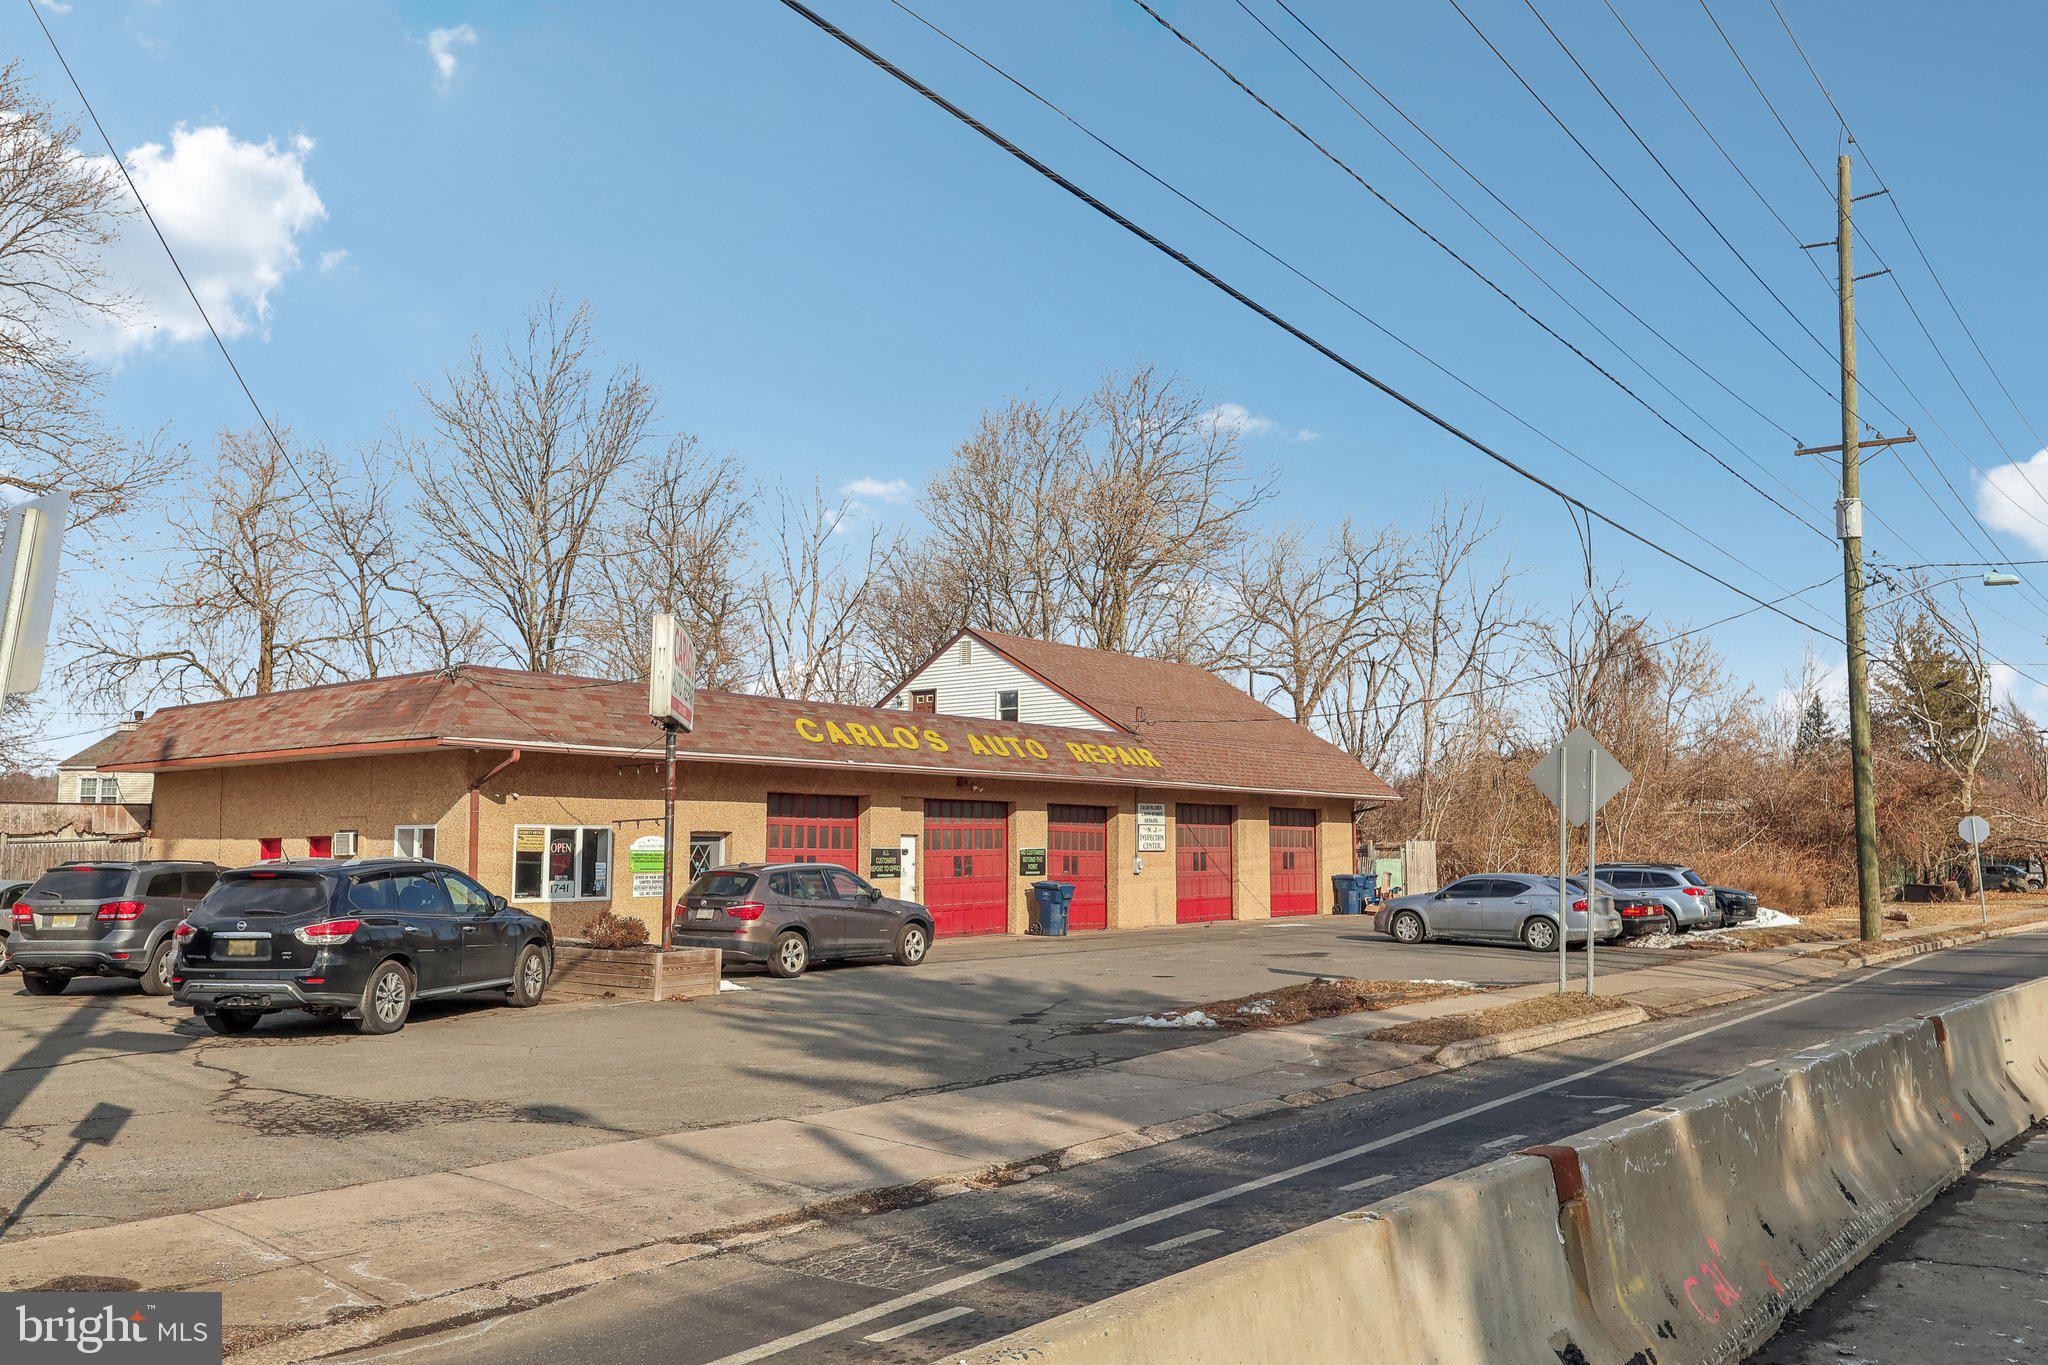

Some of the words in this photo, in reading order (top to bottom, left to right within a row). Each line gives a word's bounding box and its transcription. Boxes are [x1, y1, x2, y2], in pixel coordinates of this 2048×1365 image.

[795, 718, 949, 752] CARLO'S
[966, 733, 1049, 760] AUTO
[1065, 741, 1162, 768] REPAIR
[550, 842, 572, 853] OPEN
[550, 883, 570, 894] 1741
